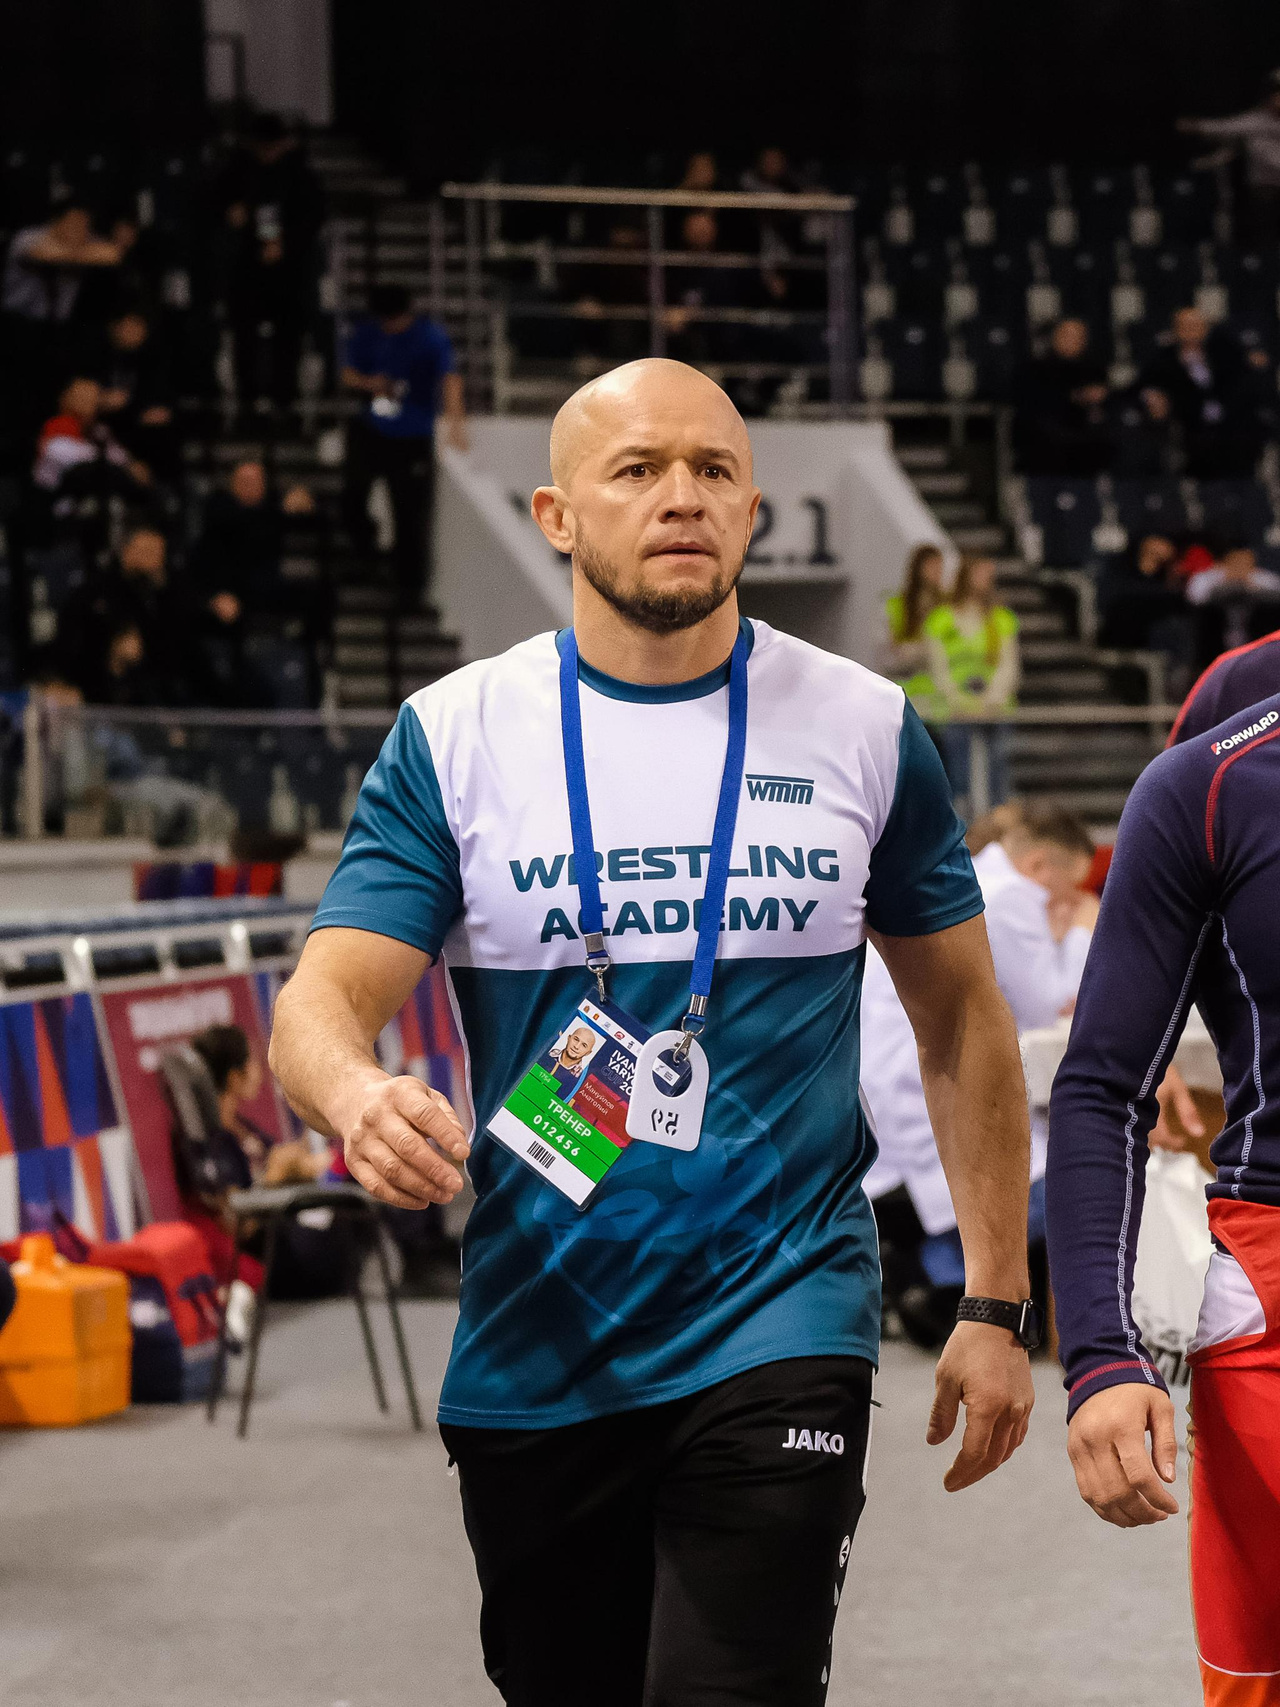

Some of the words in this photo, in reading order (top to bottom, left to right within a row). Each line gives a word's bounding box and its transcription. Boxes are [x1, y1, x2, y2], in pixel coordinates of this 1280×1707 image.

[1211, 711, 1279, 755] FORWARD
[540, 897, 819, 943] AADMY
[608, 1057, 635, 1086] YARY
[533, 1115, 580, 1156] 012456
[548, 1099, 592, 1137] ТРЕНЕР
[782, 1429, 844, 1455] JAKO
